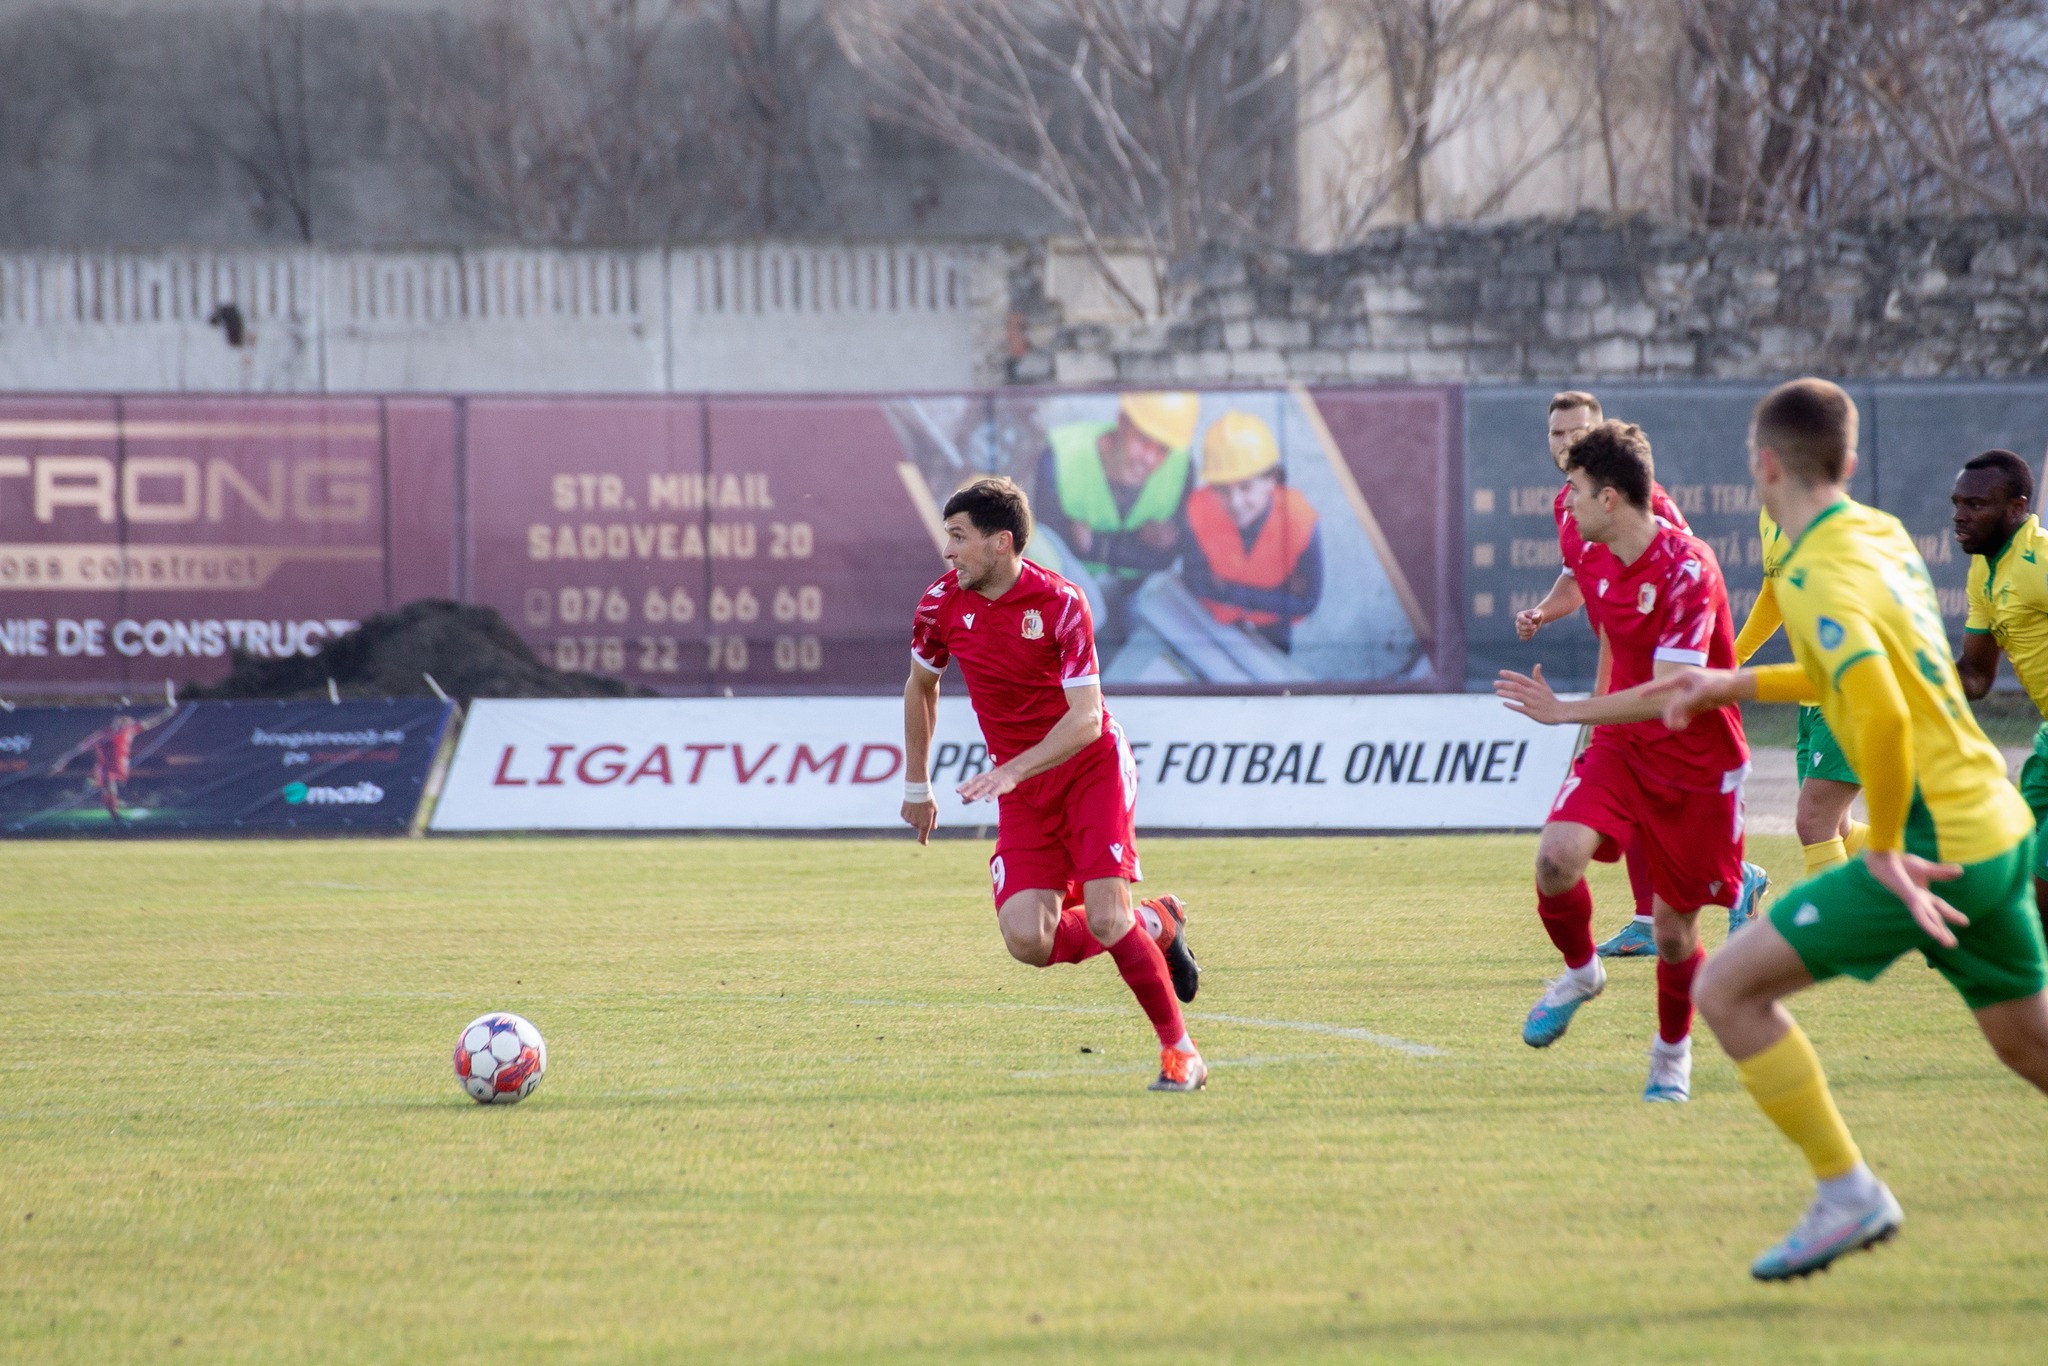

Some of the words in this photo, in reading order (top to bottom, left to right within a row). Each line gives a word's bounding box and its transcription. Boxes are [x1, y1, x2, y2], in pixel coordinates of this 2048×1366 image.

[552, 473, 637, 511] STR.
[527, 522, 757, 560] SADOVEANU
[768, 521, 814, 560] 20
[78, 554, 259, 581] construct
[557, 586, 630, 623] 076
[643, 585, 696, 623] 66
[709, 585, 760, 623] 66
[772, 585, 823, 623] 60
[56, 618, 106, 657] DE
[773, 634, 823, 672] 00
[491, 743, 903, 786] LIGATV.MD
[1157, 742, 1327, 784] FOTBAL
[1343, 740, 1528, 784] ONLINE!
[303, 780, 385, 804] maib
